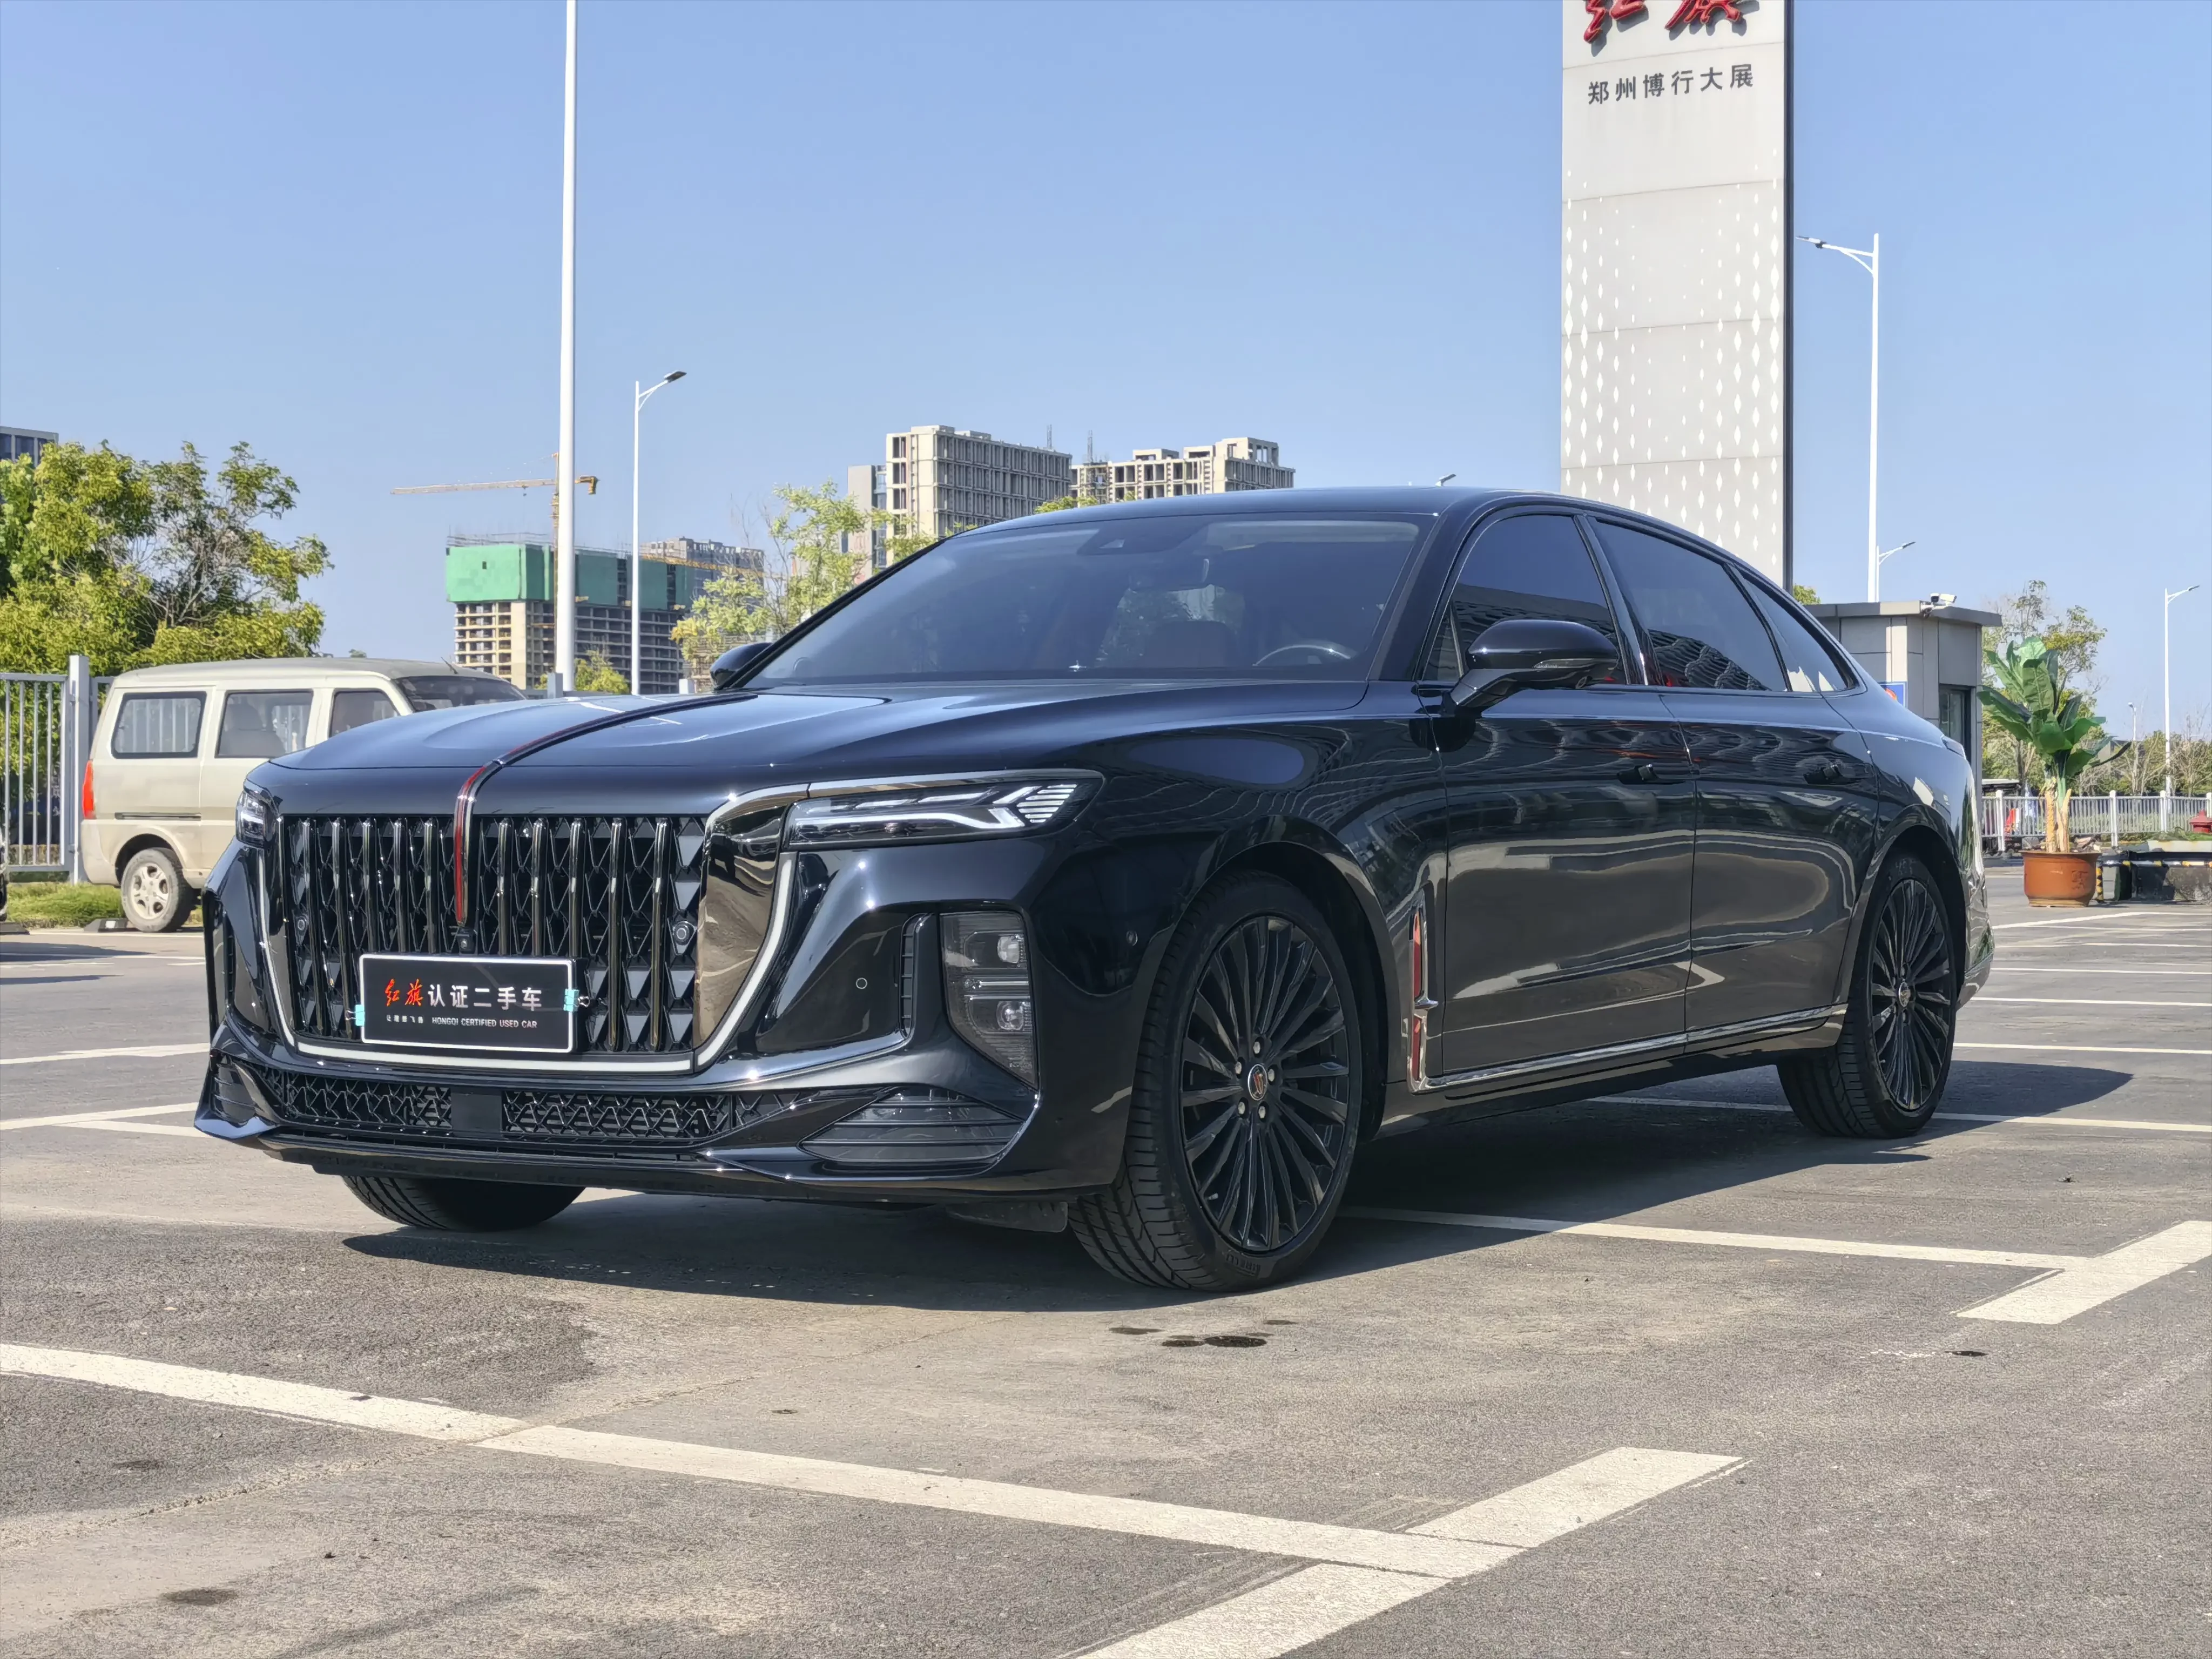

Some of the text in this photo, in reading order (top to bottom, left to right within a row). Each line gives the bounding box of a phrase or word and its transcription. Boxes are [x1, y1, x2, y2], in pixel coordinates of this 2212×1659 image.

[1588, 64, 1754, 105] 郑州博行大展
[431, 1016, 458, 1026] HONGQI
[461, 1018, 497, 1027] CERTIFIED
[500, 1019, 519, 1028] USED
[521, 1020, 538, 1028] CAR
